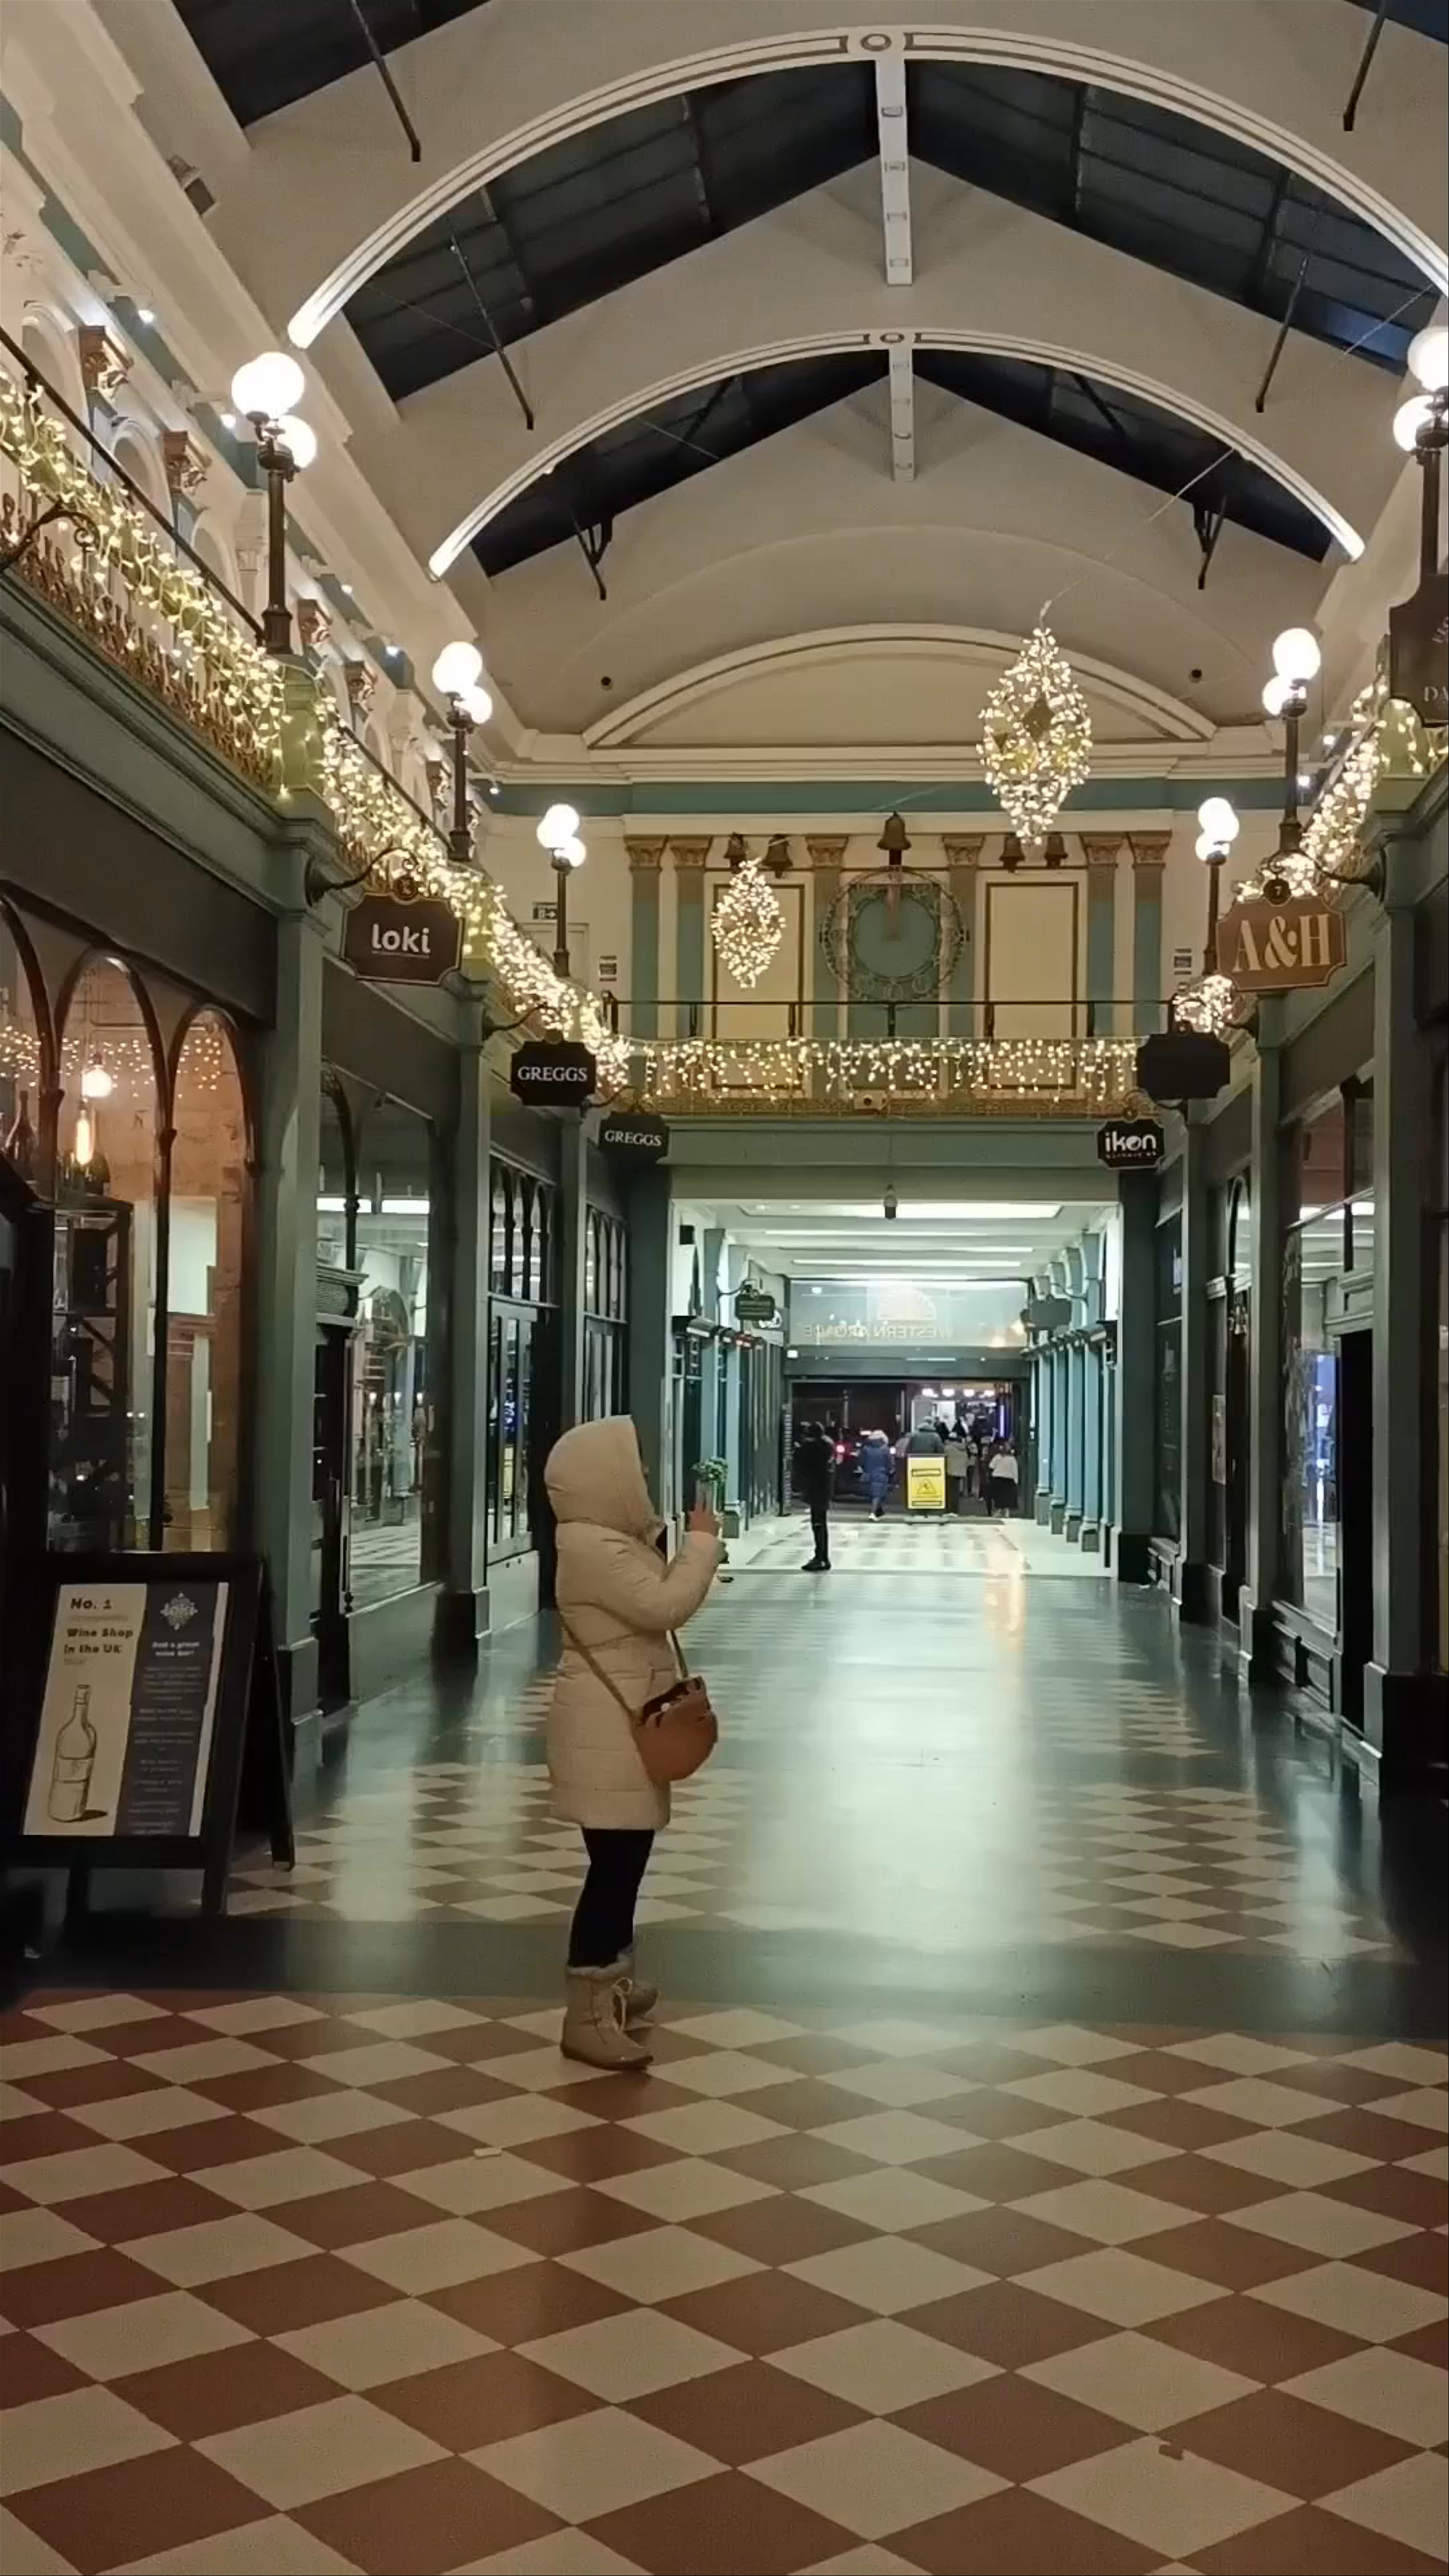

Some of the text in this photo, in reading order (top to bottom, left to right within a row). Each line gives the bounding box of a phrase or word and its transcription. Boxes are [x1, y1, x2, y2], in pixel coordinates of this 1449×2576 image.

[372, 924, 431, 954] loki
[1232, 914, 1331, 972] A&H
[518, 1066, 588, 1082] GREGGS
[605, 1130, 663, 1147] GREGGS
[1105, 1130, 1157, 1152] ikon
[70, 1598, 112, 1610] No. 1
[67, 1628, 134, 1639] Wine Shop
[79, 1644, 100, 1653] the
[103, 1644, 123, 1654] UK
